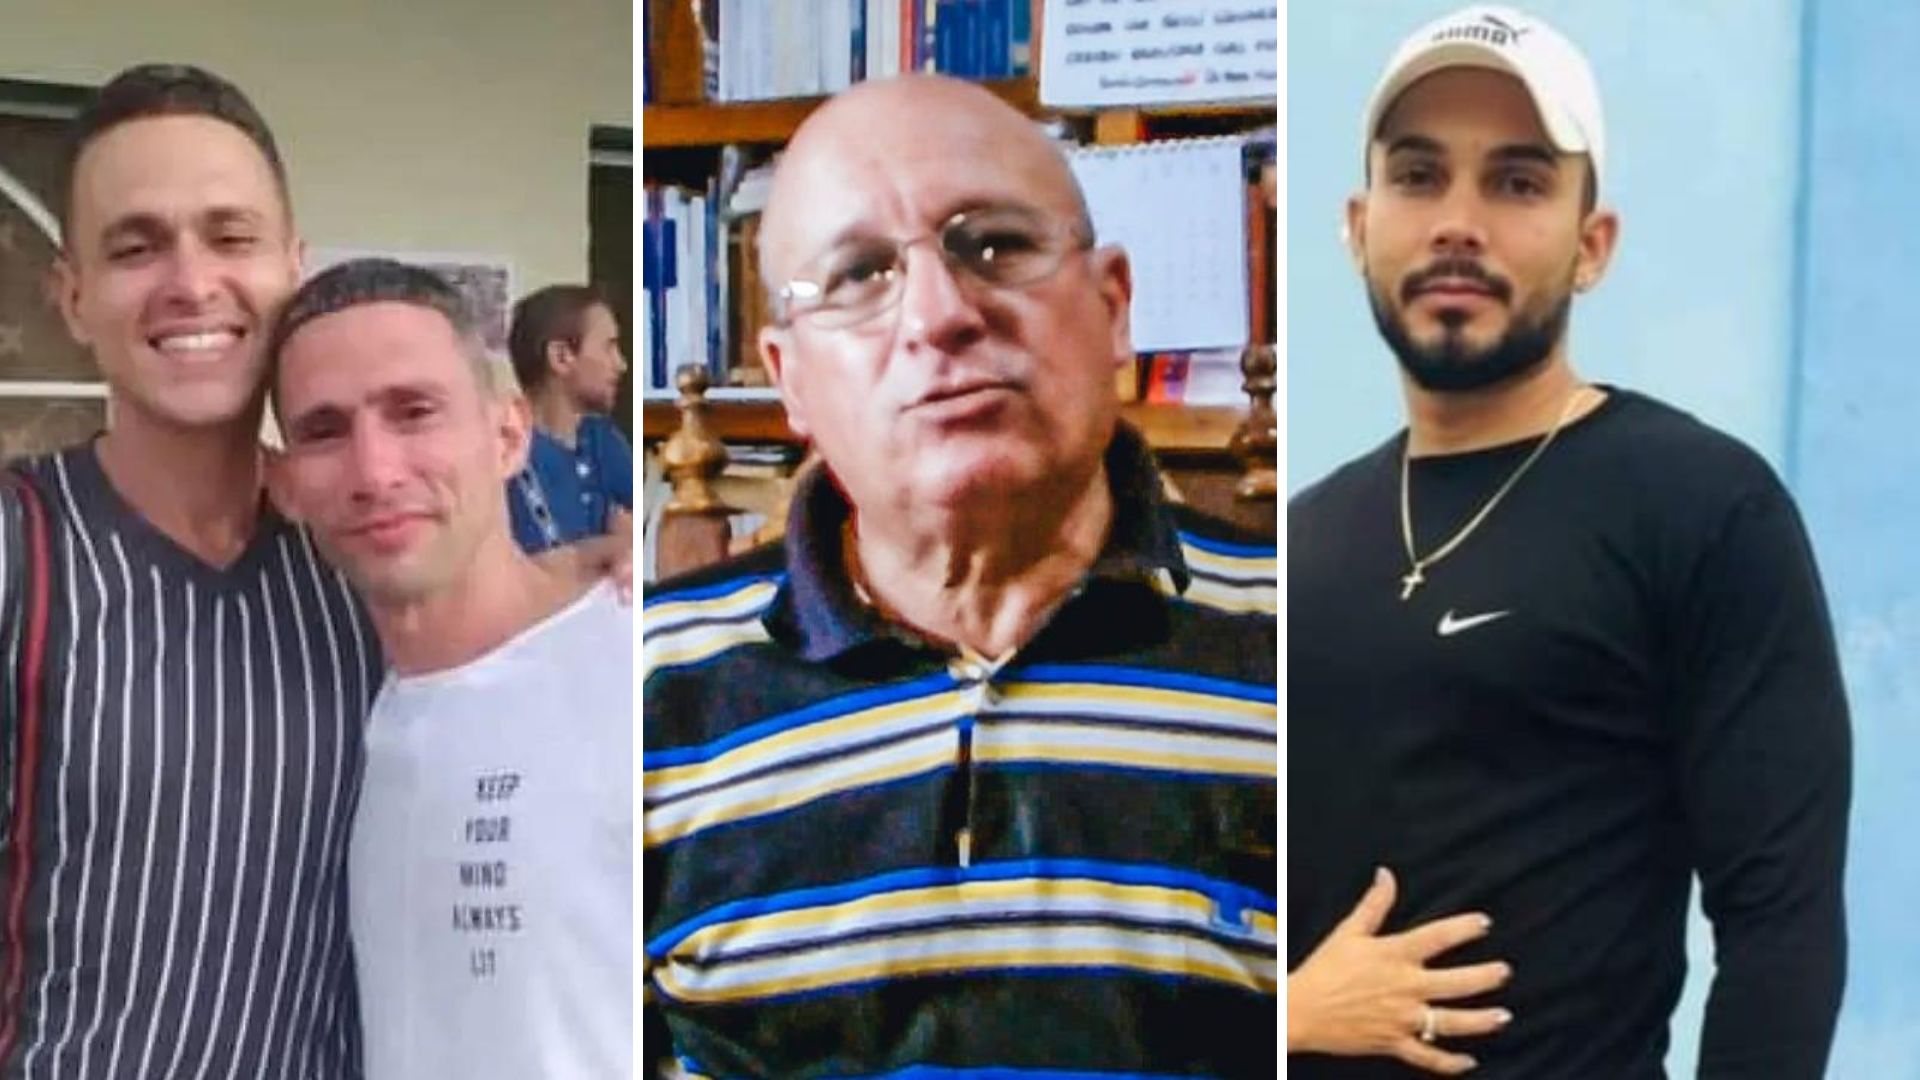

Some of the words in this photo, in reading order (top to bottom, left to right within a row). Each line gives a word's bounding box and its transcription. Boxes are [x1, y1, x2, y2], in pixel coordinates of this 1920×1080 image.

[465, 815, 511, 842] YOUR
[459, 860, 506, 888] MIND
[452, 903, 523, 931] ALWAYS
